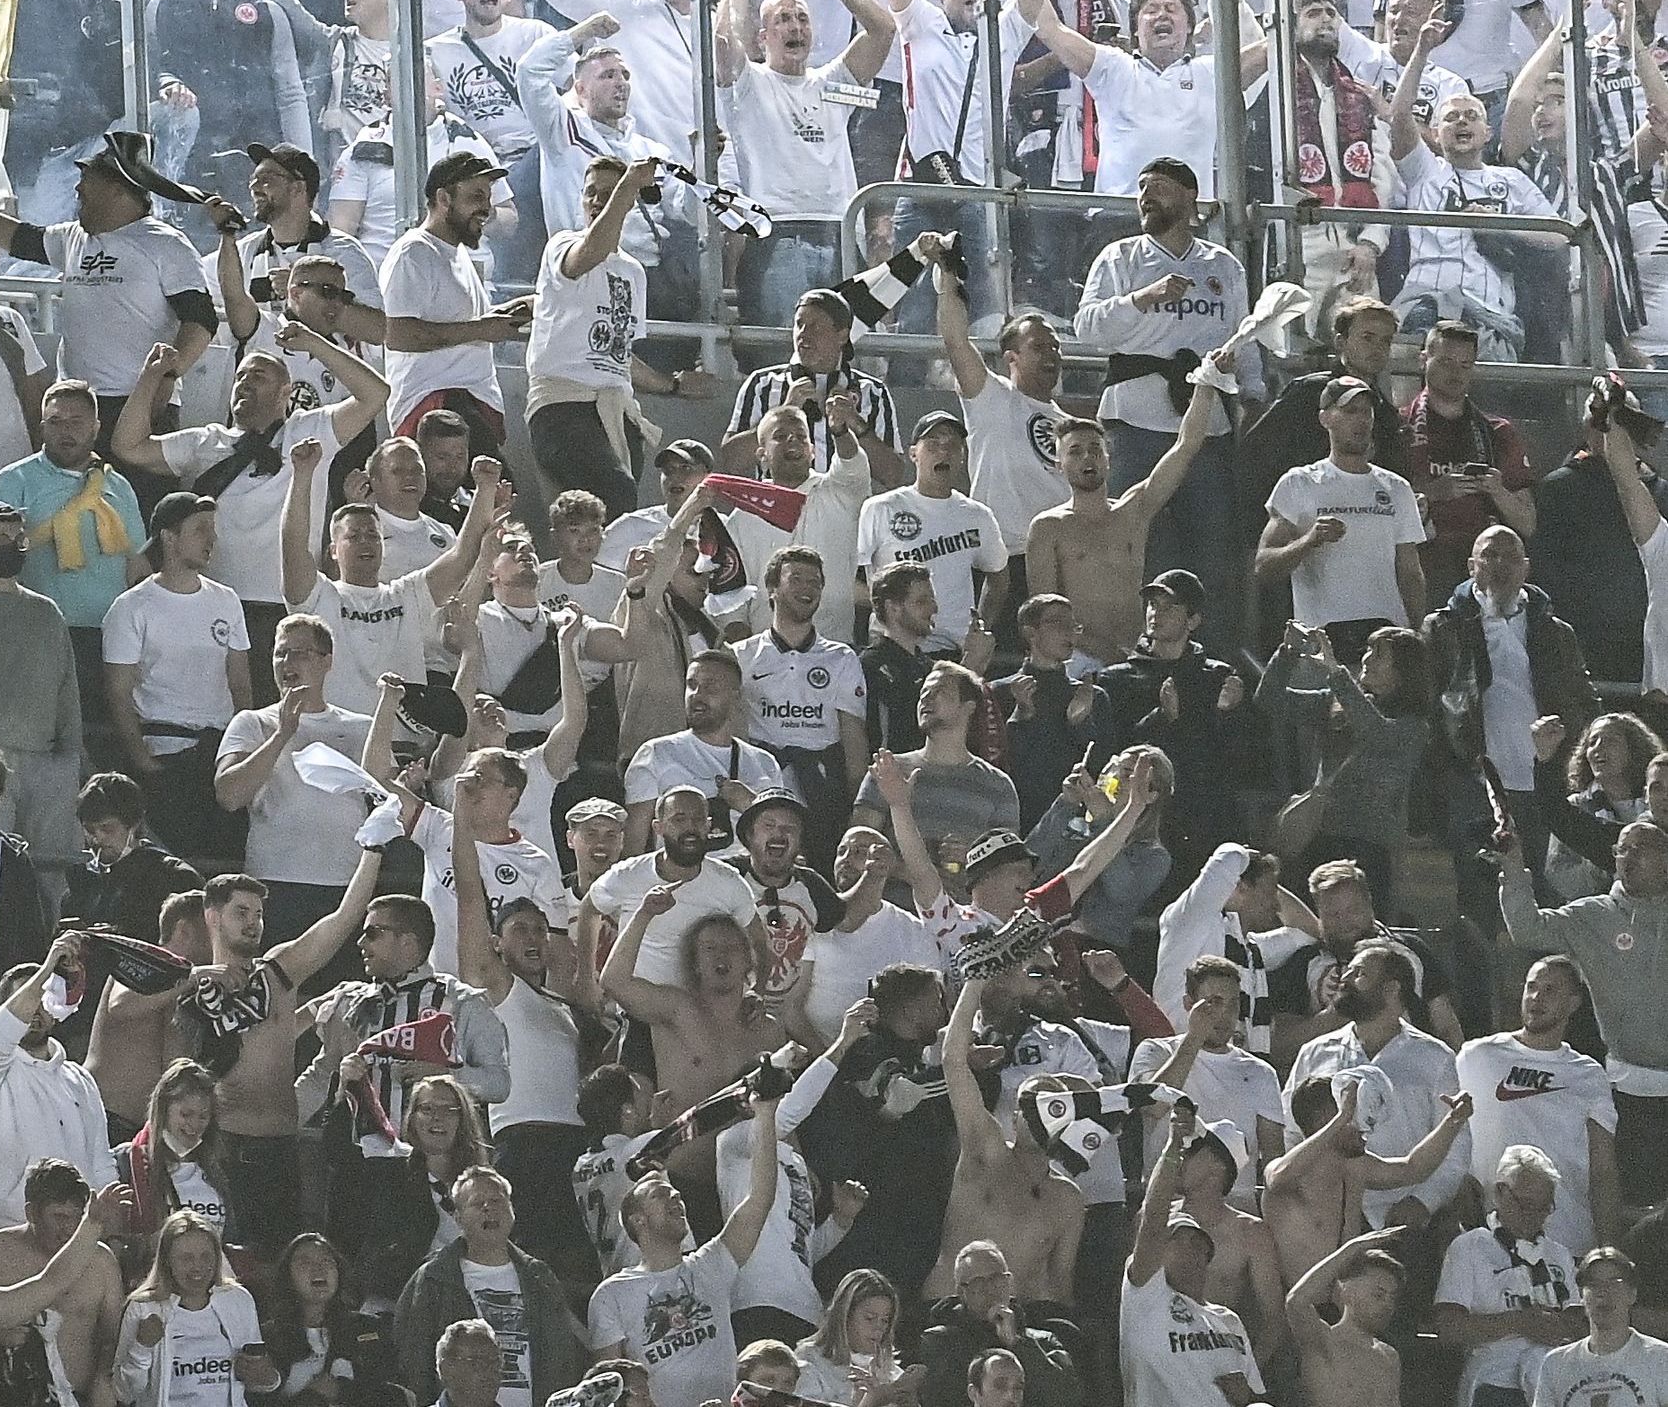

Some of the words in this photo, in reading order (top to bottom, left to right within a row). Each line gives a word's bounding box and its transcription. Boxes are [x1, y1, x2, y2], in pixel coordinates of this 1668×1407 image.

[1151, 295, 1226, 322] raport
[762, 696, 824, 719] indeed
[1506, 1066, 1556, 1089] NIKE
[644, 1324, 718, 1366] EUROPA
[173, 1356, 231, 1378] indee
